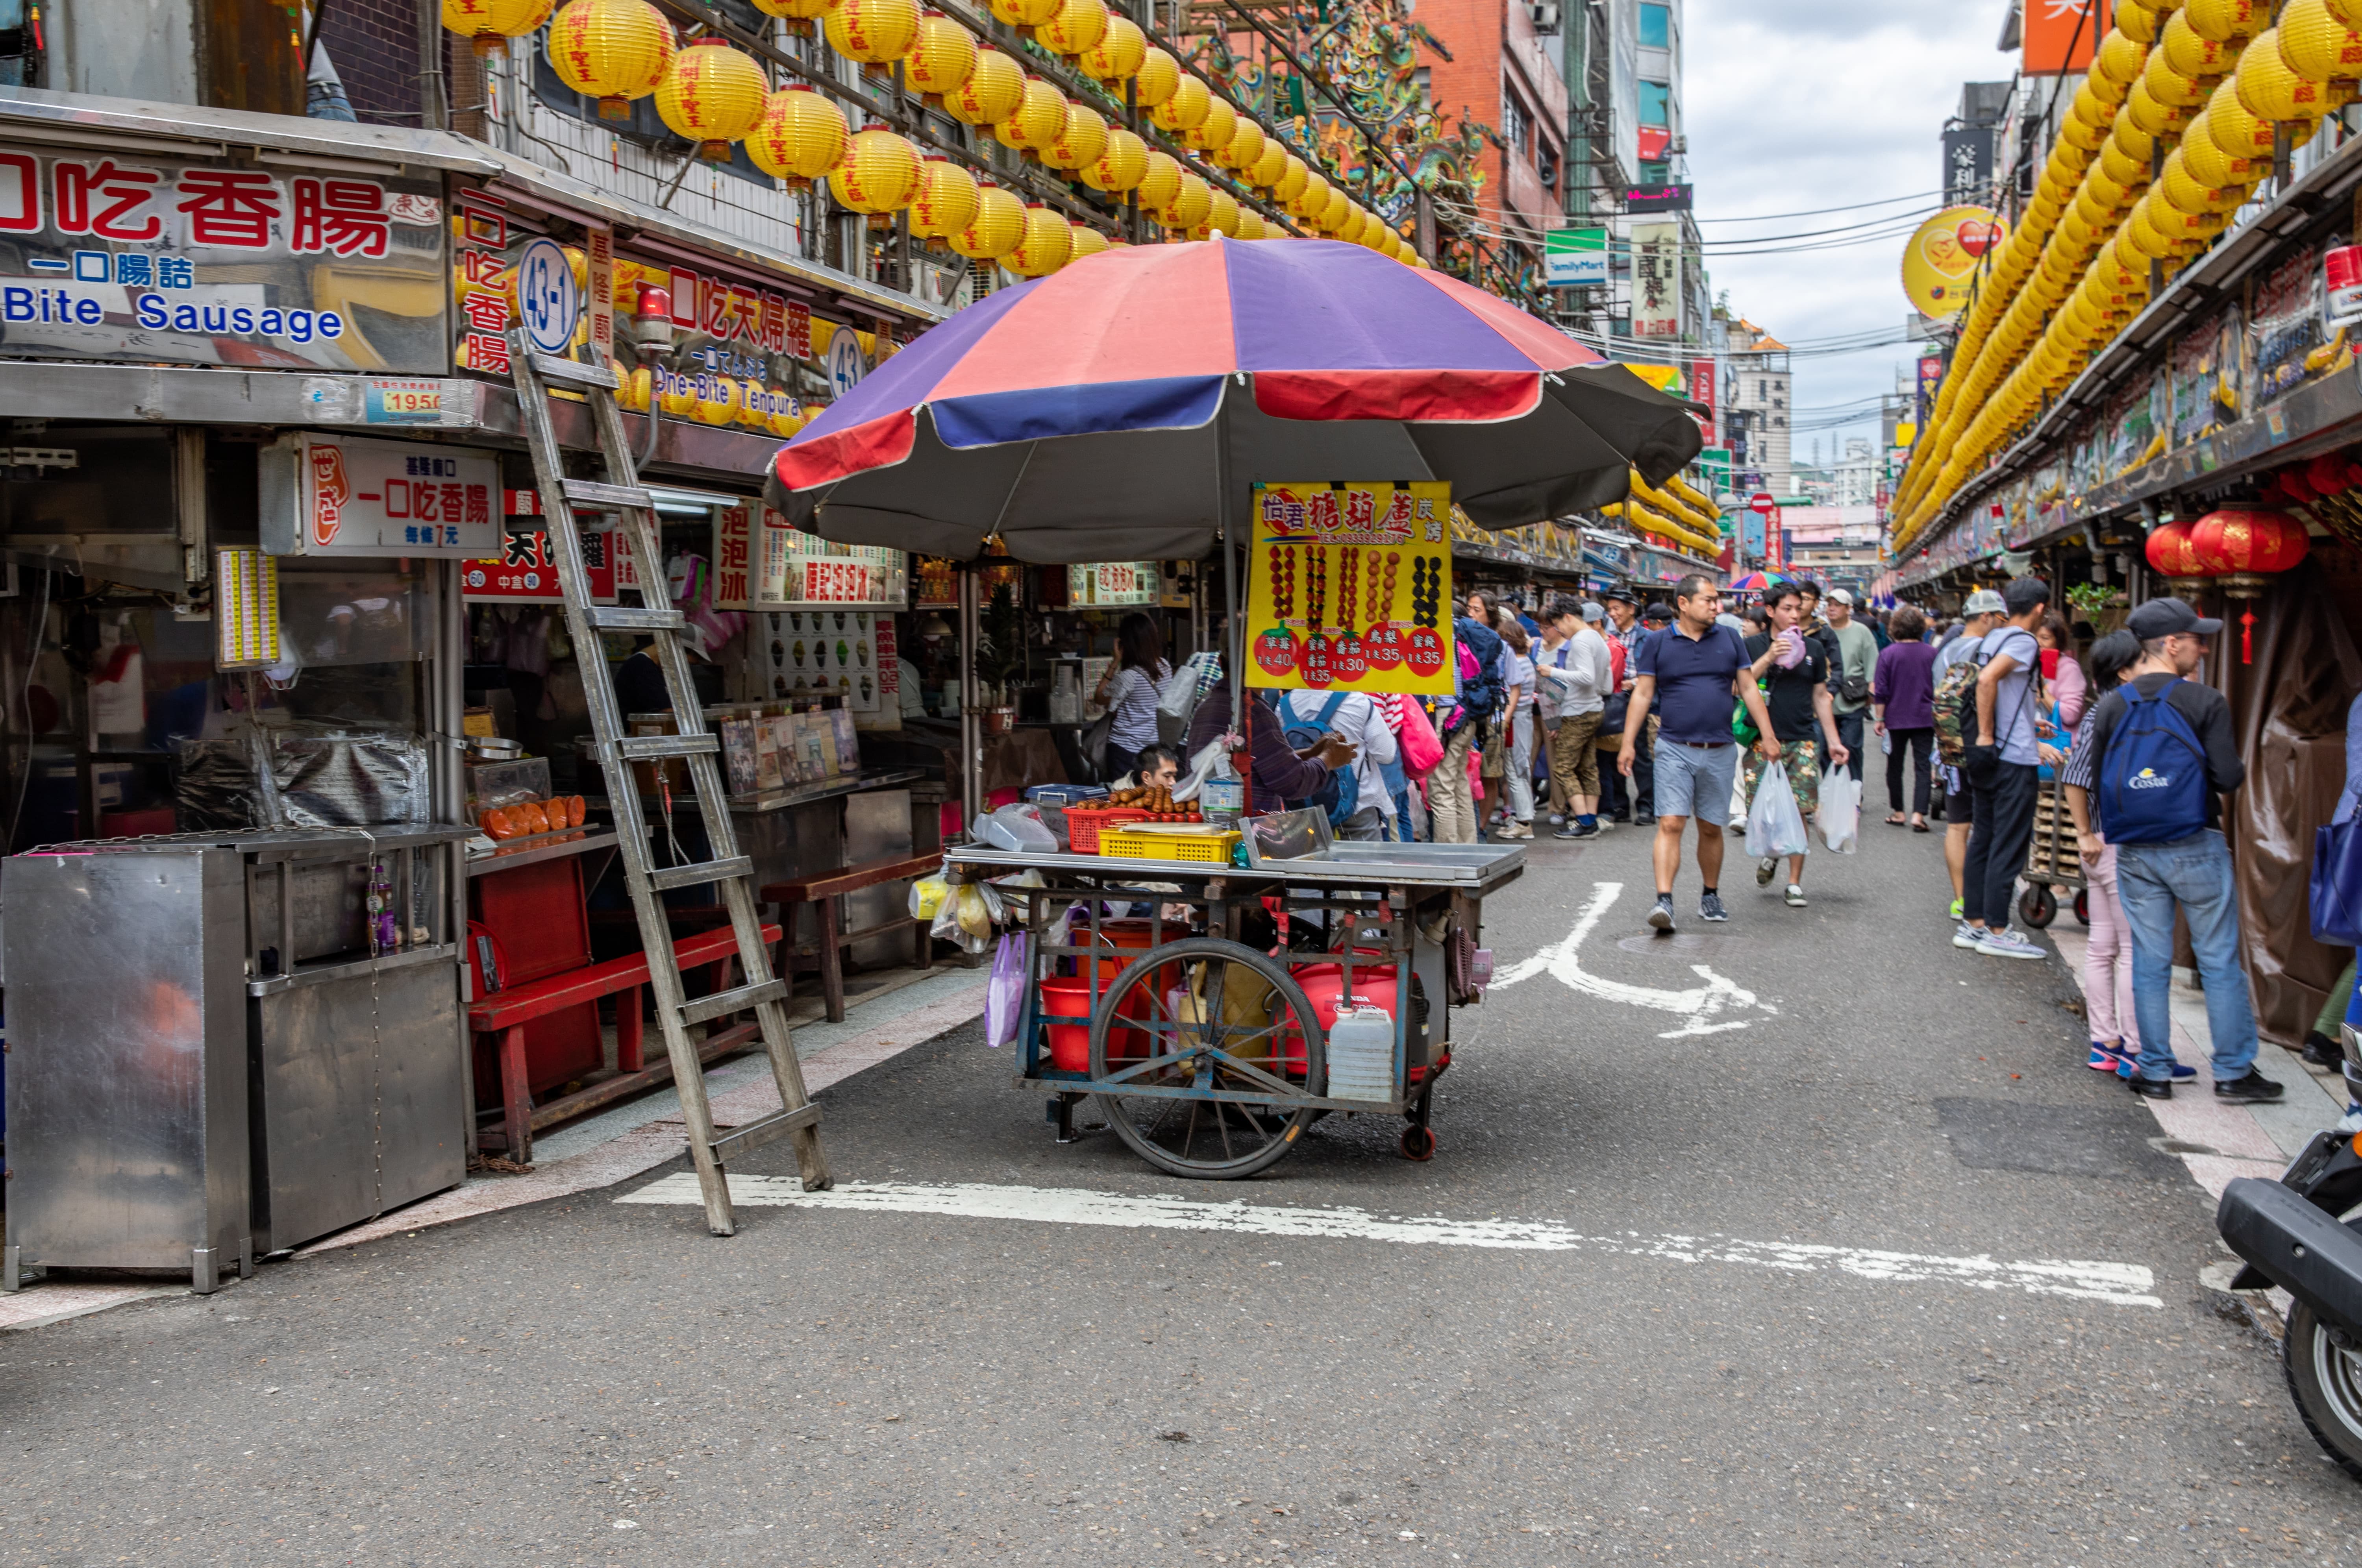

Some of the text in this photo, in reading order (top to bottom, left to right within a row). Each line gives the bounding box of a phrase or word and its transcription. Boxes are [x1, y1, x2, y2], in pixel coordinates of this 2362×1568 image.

[31, 251, 194, 289] 一口腸詰
[4, 287, 342, 343] Bite Sausage
[738, 382, 799, 420] Tenpura
[357, 479, 489, 524] 一口吃香腸
